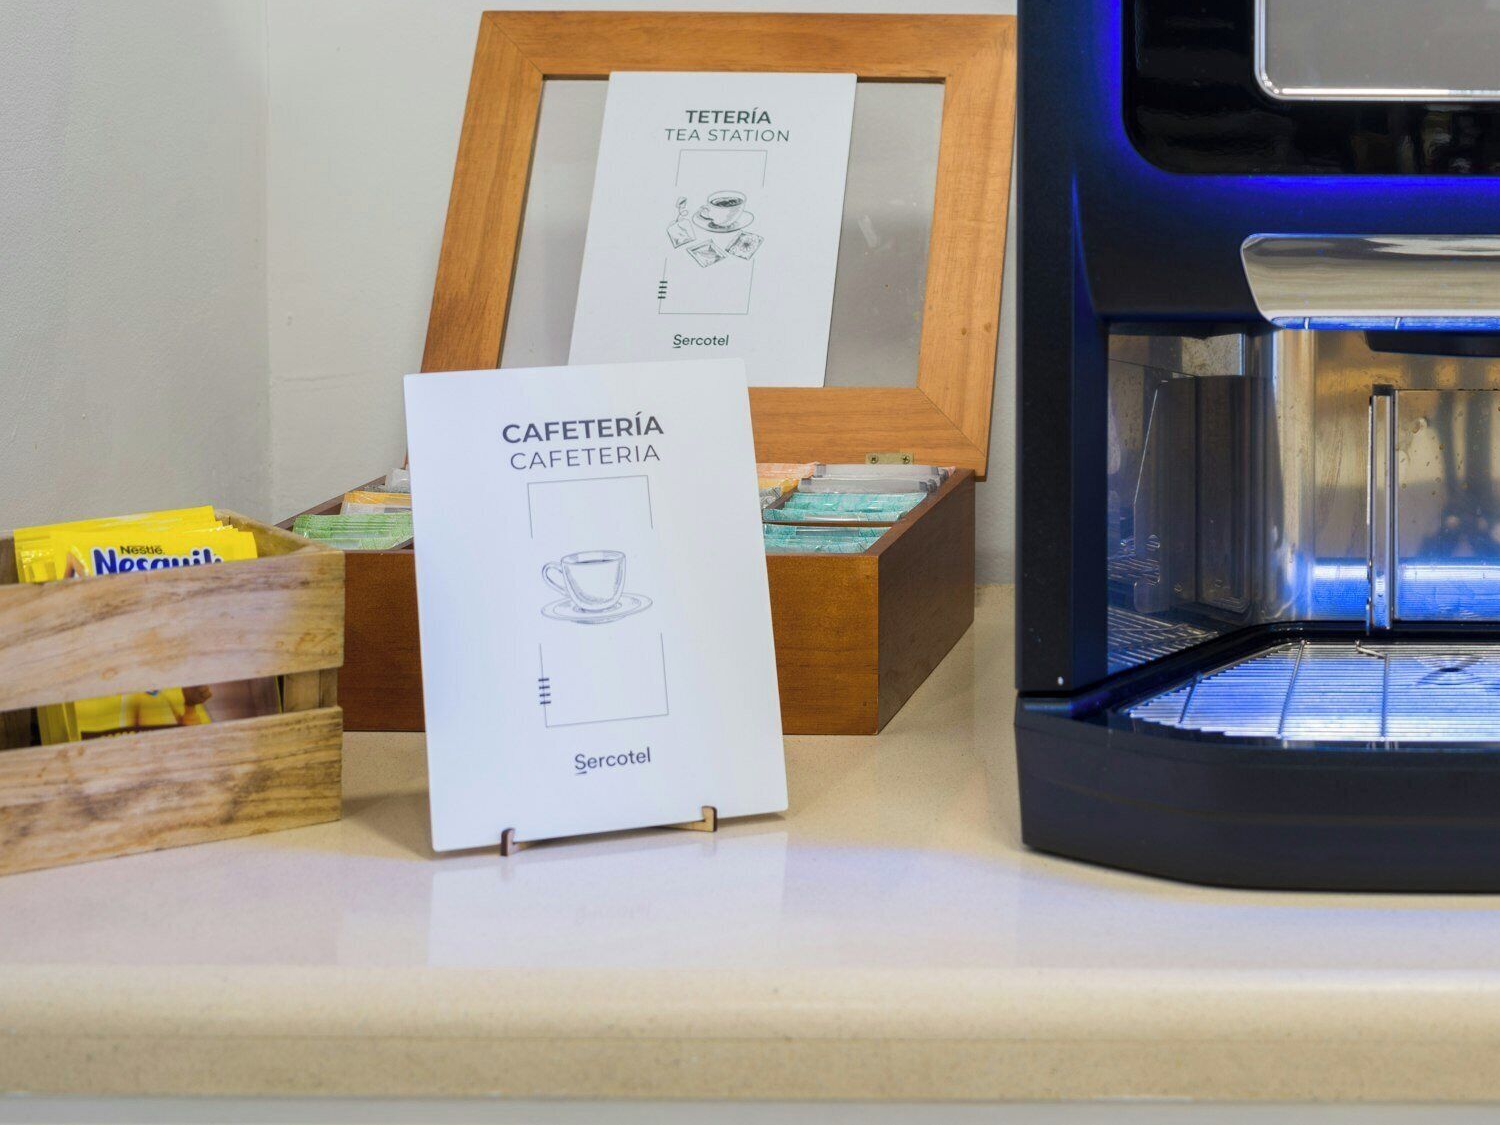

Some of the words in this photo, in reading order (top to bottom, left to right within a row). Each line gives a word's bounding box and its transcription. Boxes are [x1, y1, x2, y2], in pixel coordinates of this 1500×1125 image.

[685, 107, 772, 124] TETERÍA
[665, 128, 700, 141] TEA
[708, 129, 790, 142] STATION
[673, 334, 730, 348] Sercotel
[502, 411, 664, 444] CAFETERÍA
[510, 444, 661, 470] CAFETERIA
[575, 746, 651, 775] Sercotel
